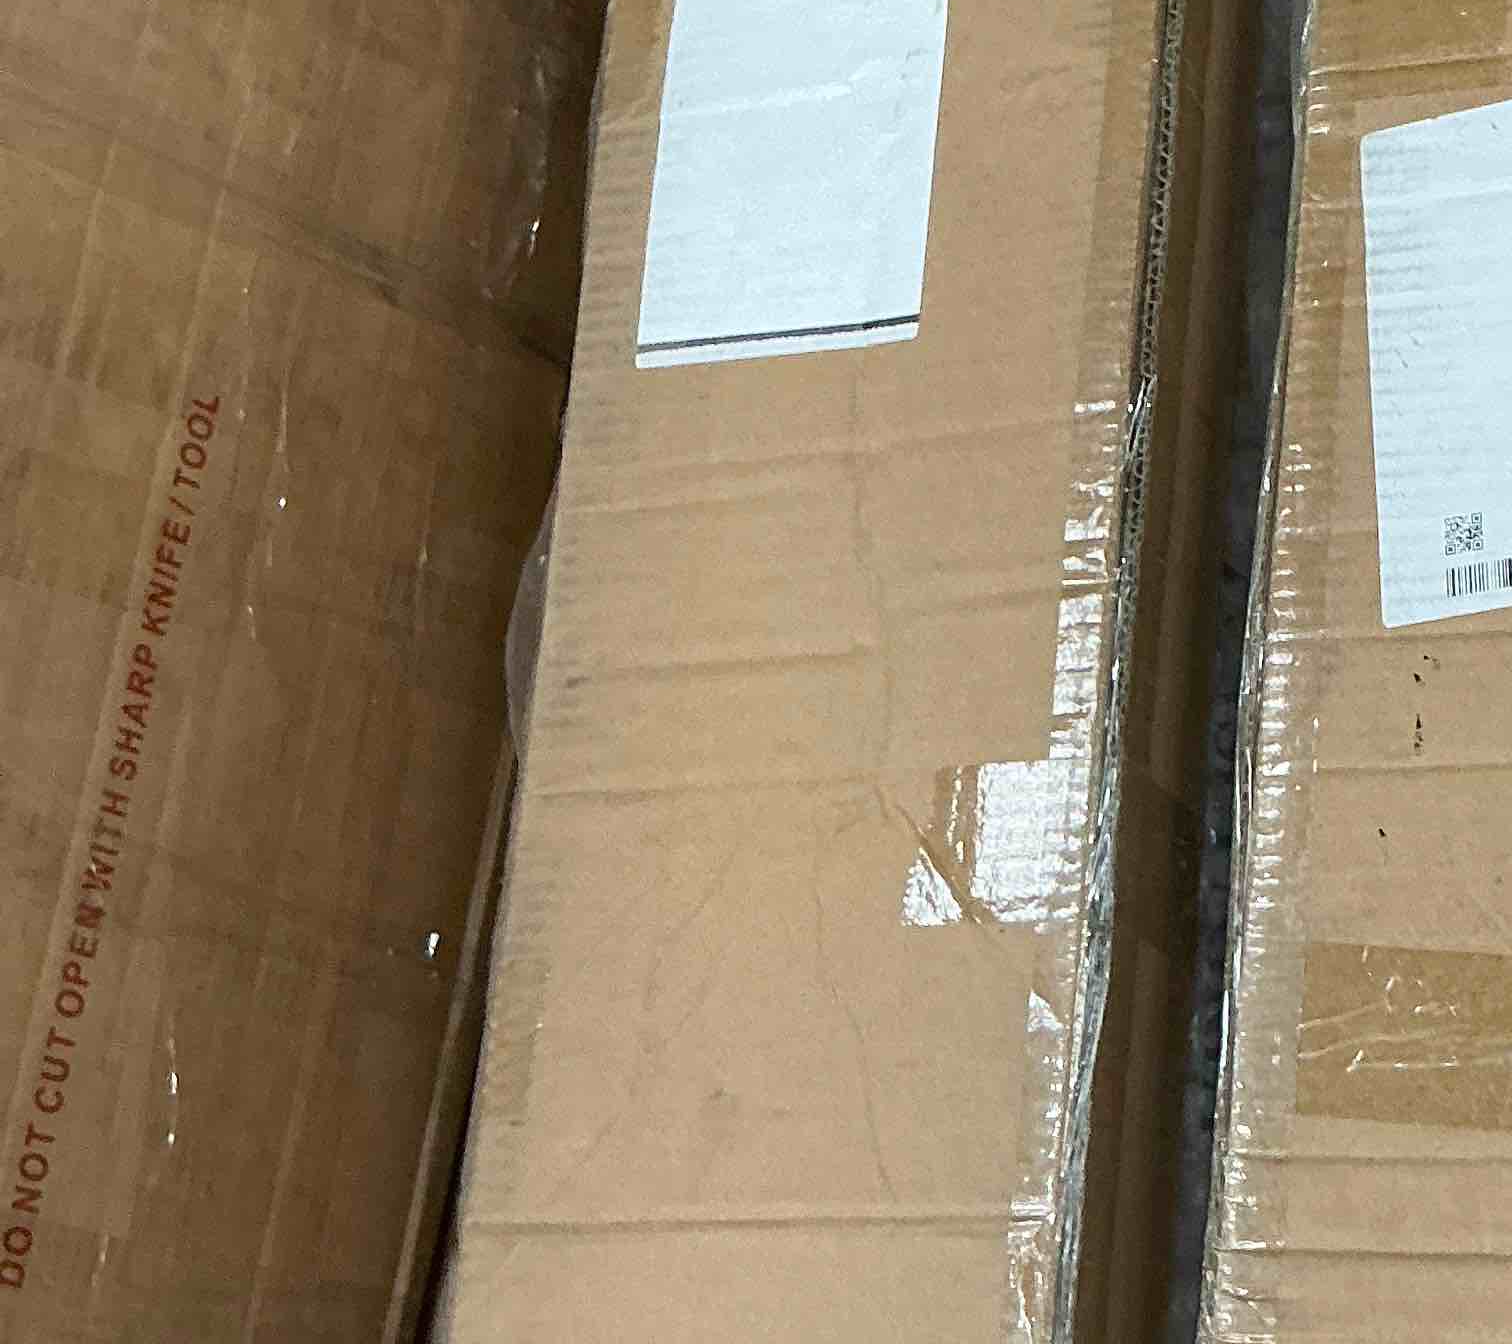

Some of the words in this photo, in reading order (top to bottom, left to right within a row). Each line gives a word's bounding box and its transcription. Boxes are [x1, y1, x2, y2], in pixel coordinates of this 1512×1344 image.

[173, 394, 221, 489] TOOL
[140, 518, 193, 638] KNIFE
[108, 643, 160, 781] SHARP
[81, 789, 130, 893] WITH
[55, 899, 106, 1019] OPEN
[34, 1027, 76, 1115] CUT
[12, 1121, 56, 1214] NOT
[0, 1226, 33, 1289] DO
